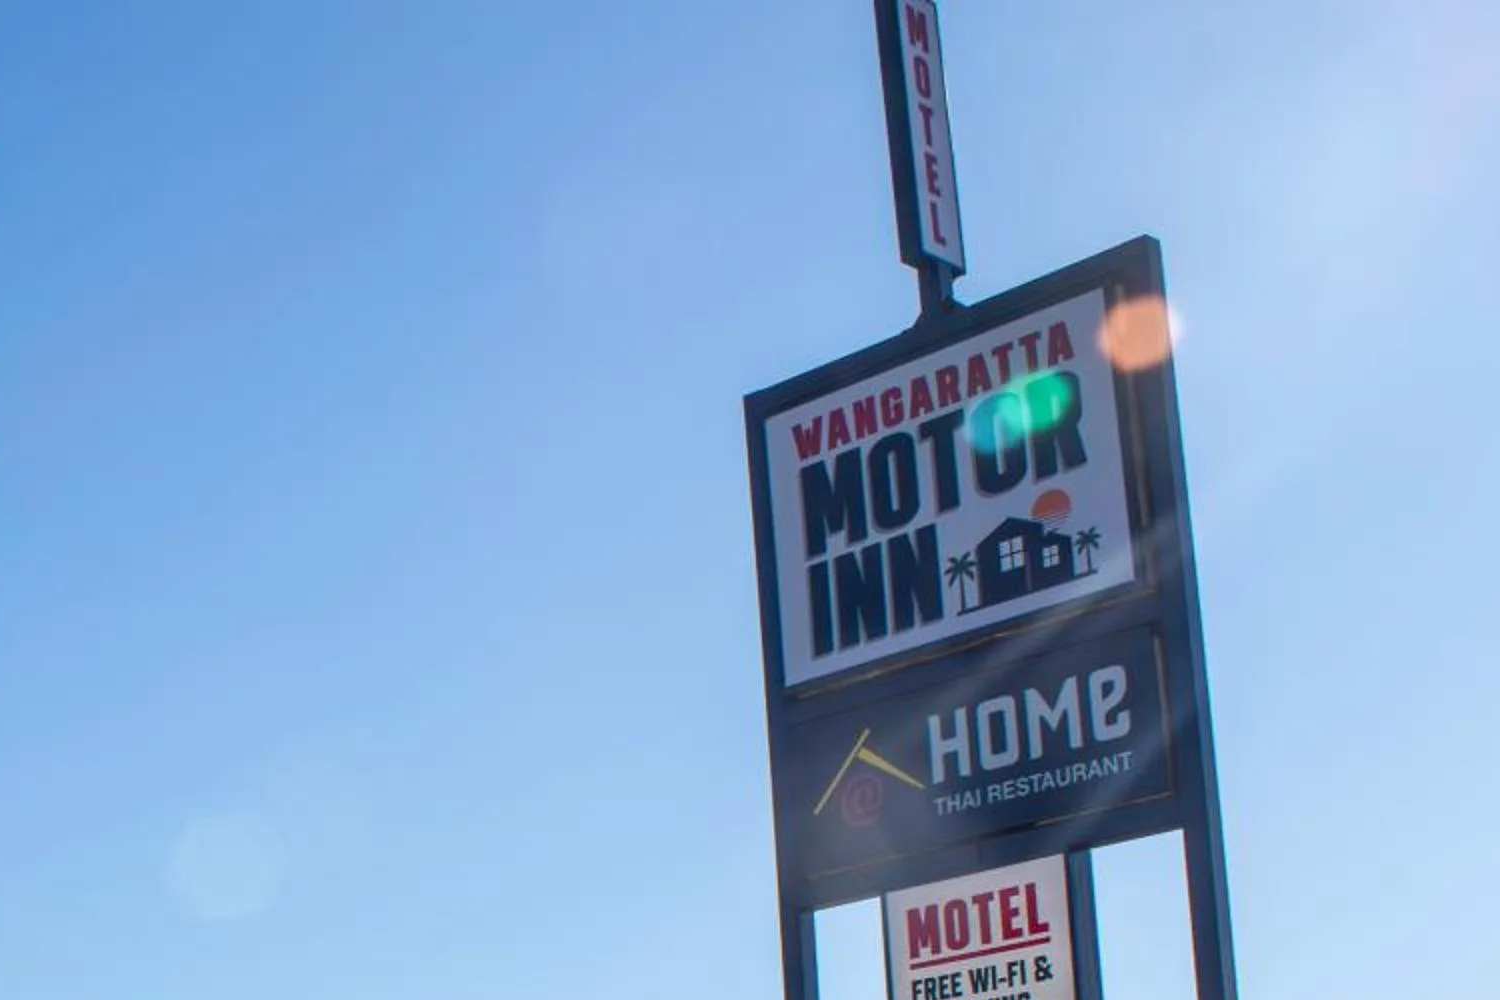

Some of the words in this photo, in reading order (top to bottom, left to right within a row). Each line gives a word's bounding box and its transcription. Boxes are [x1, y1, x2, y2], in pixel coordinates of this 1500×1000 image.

[904, 2, 947, 248] MOTEL
[791, 320, 1076, 461] WANGARATTA
[799, 370, 1088, 560] MOTOR
[807, 523, 944, 661] INN
[933, 788, 982, 816] THAI
[987, 751, 1134, 804] RESTAURANT
[906, 882, 1050, 960] MOTEL
[968, 959, 1027, 995] WI-FI
[1034, 955, 1053, 983] &
